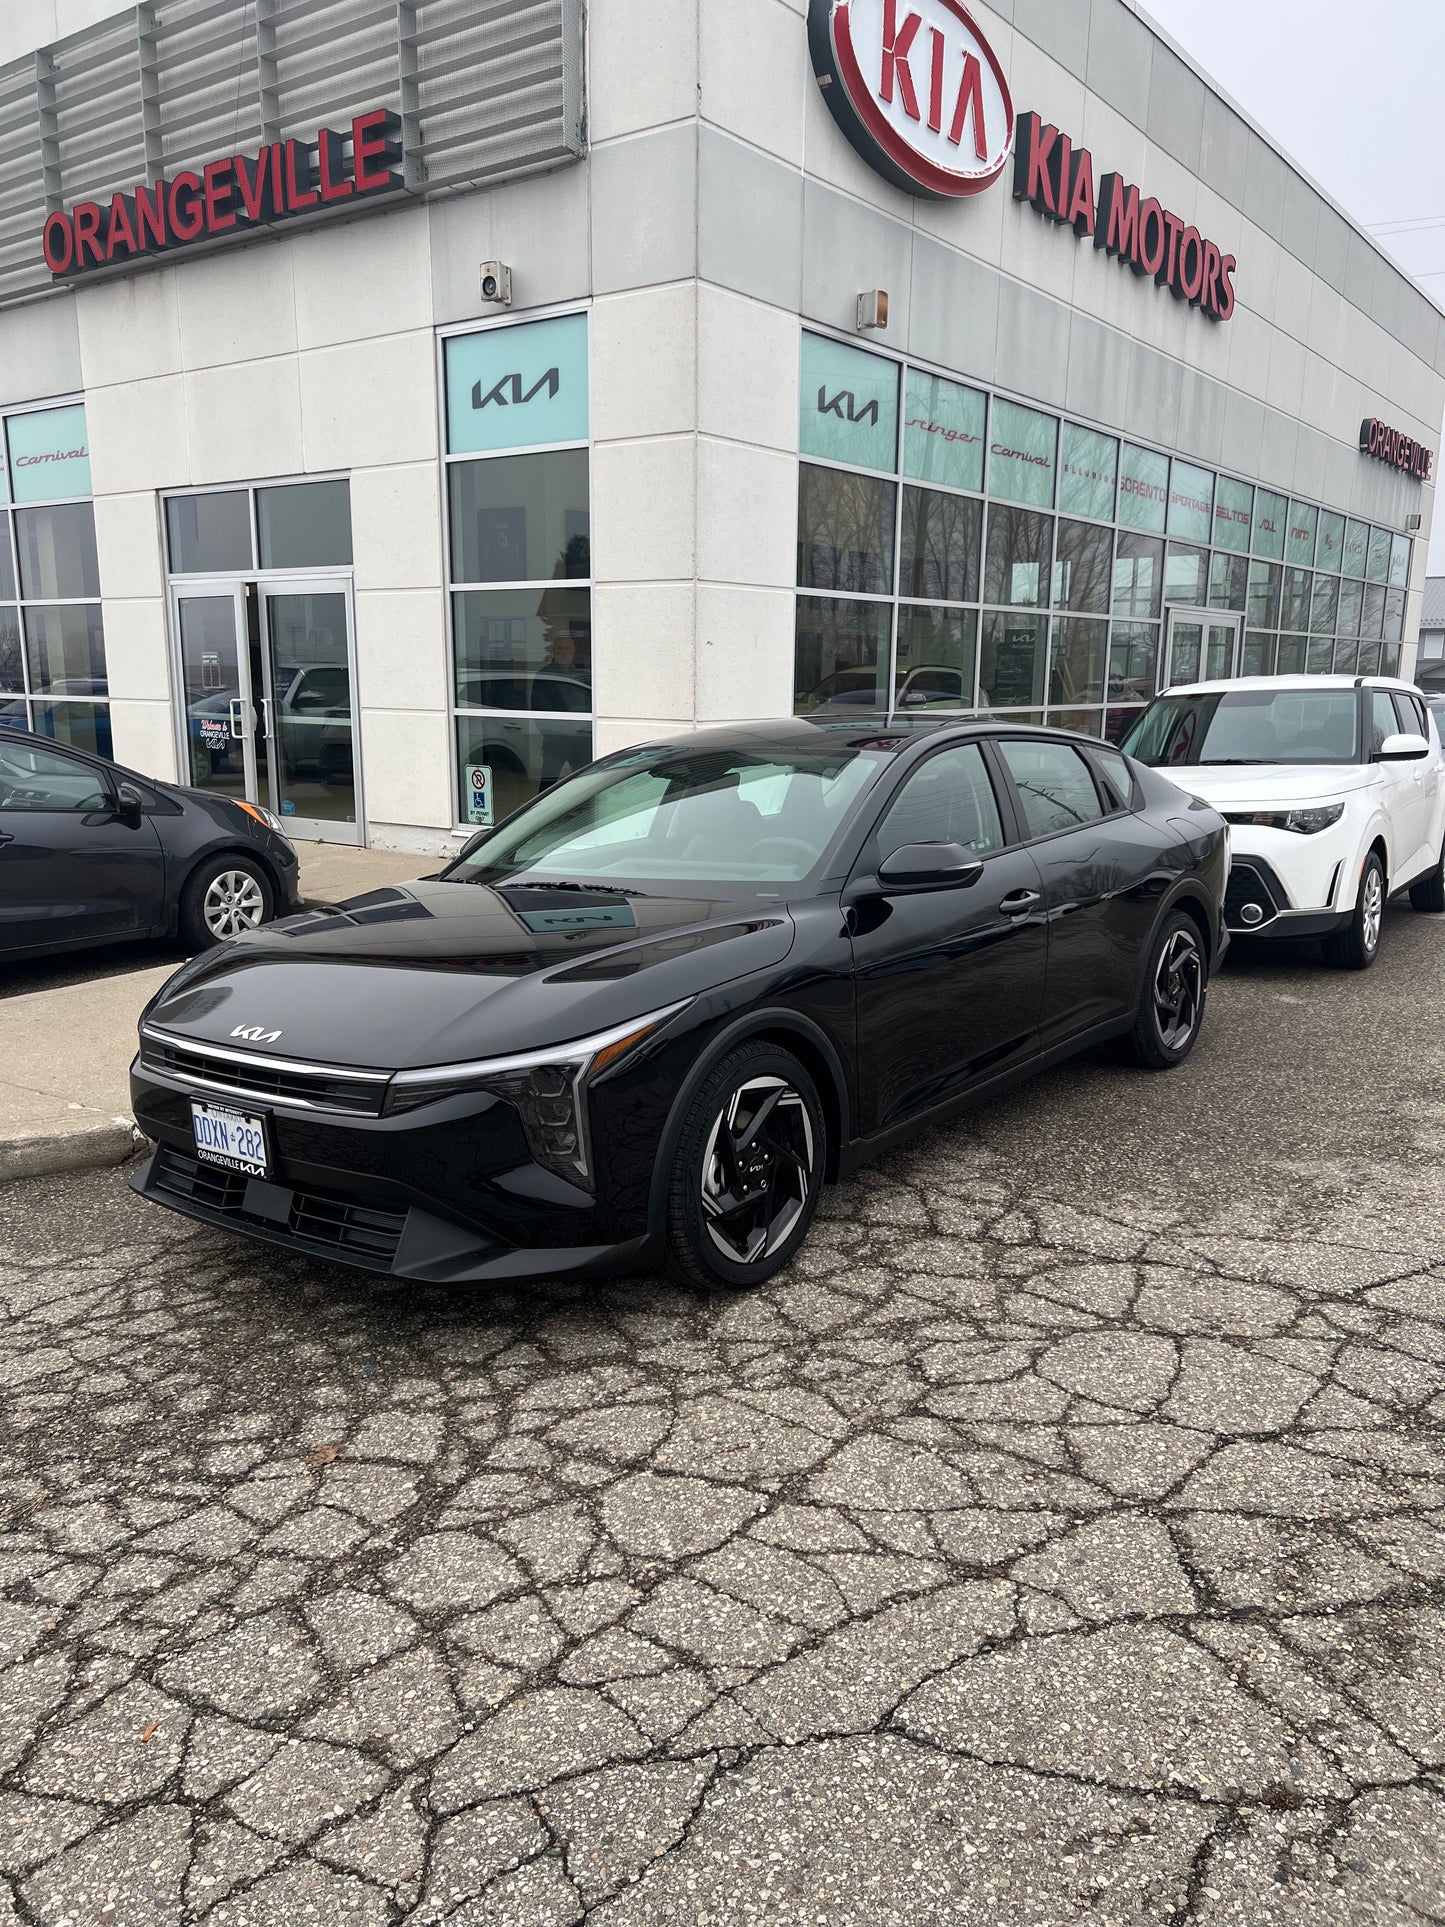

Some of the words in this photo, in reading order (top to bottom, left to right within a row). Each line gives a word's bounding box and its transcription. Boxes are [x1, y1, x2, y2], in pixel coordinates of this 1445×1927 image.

[878, 0, 988, 162] KIA
[42, 109, 392, 274] ORANGEVILLE
[1024, 111, 1095, 238] KIA
[1104, 172, 1237, 321] MOTORS
[471, 367, 559, 410] KIA
[817, 384, 879, 428] KIA
[15, 446, 90, 467] Carnival
[990, 443, 1051, 468] Carnival
[1367, 417, 1434, 481] ORANGEVILLE
[1064, 464, 1117, 486] ELLURIDE
[1119, 476, 1168, 503] SORENTO
[1170, 491, 1212, 514] SPORTAGE
[1215, 505, 1251, 525] SELTOS
[200, 729, 231, 740] ORANGEVILLE
[229, 1023, 284, 1044] KIA
[193, 1114, 230, 1151] DDXN
[236, 1126, 265, 1162] 282
[197, 1149, 240, 1170] ORANGEVILLE
[240, 1161, 265, 1177] KIA
